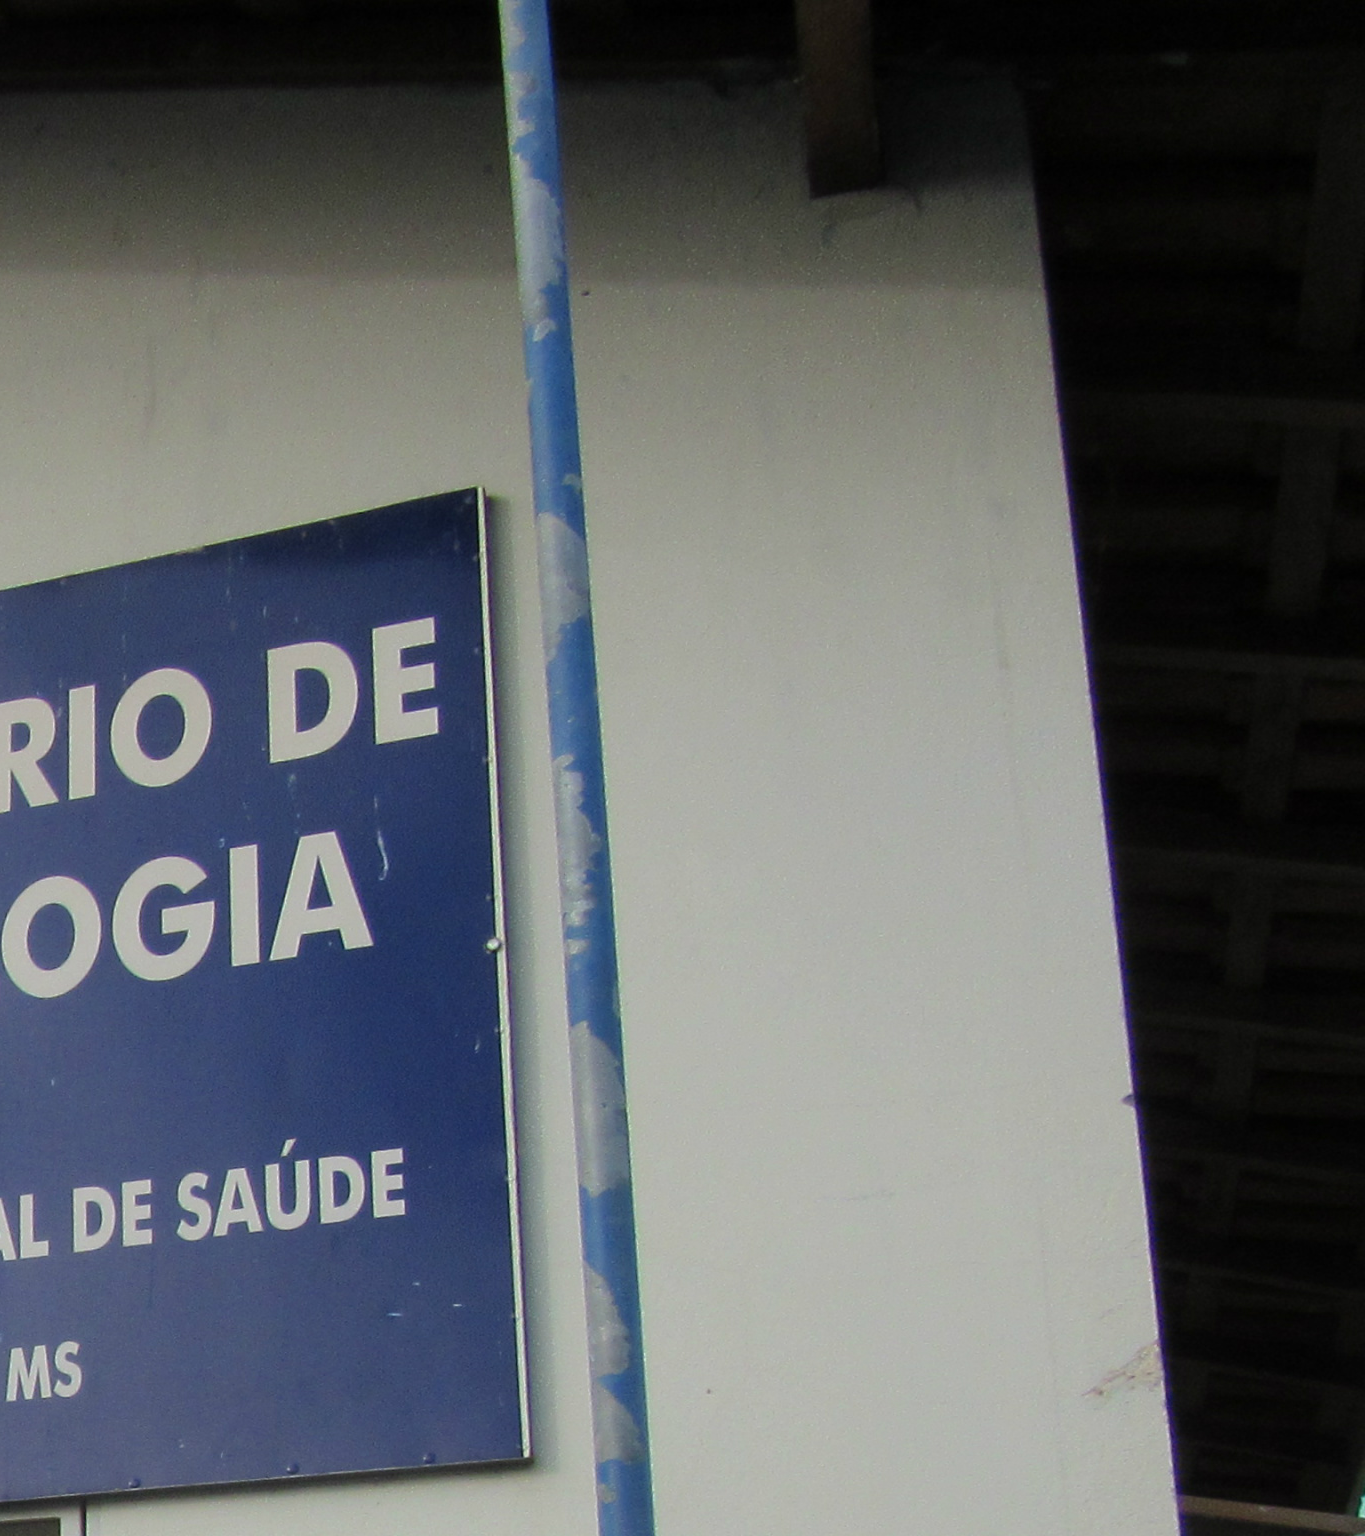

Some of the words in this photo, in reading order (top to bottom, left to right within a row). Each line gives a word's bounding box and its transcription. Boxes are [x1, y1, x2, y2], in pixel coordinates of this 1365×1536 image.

[267, 617, 440, 764] DE
[72, 1178, 154, 1253] DE
[176, 1140, 407, 1243] SAÚDE
[5, 1340, 84, 1403] MS
